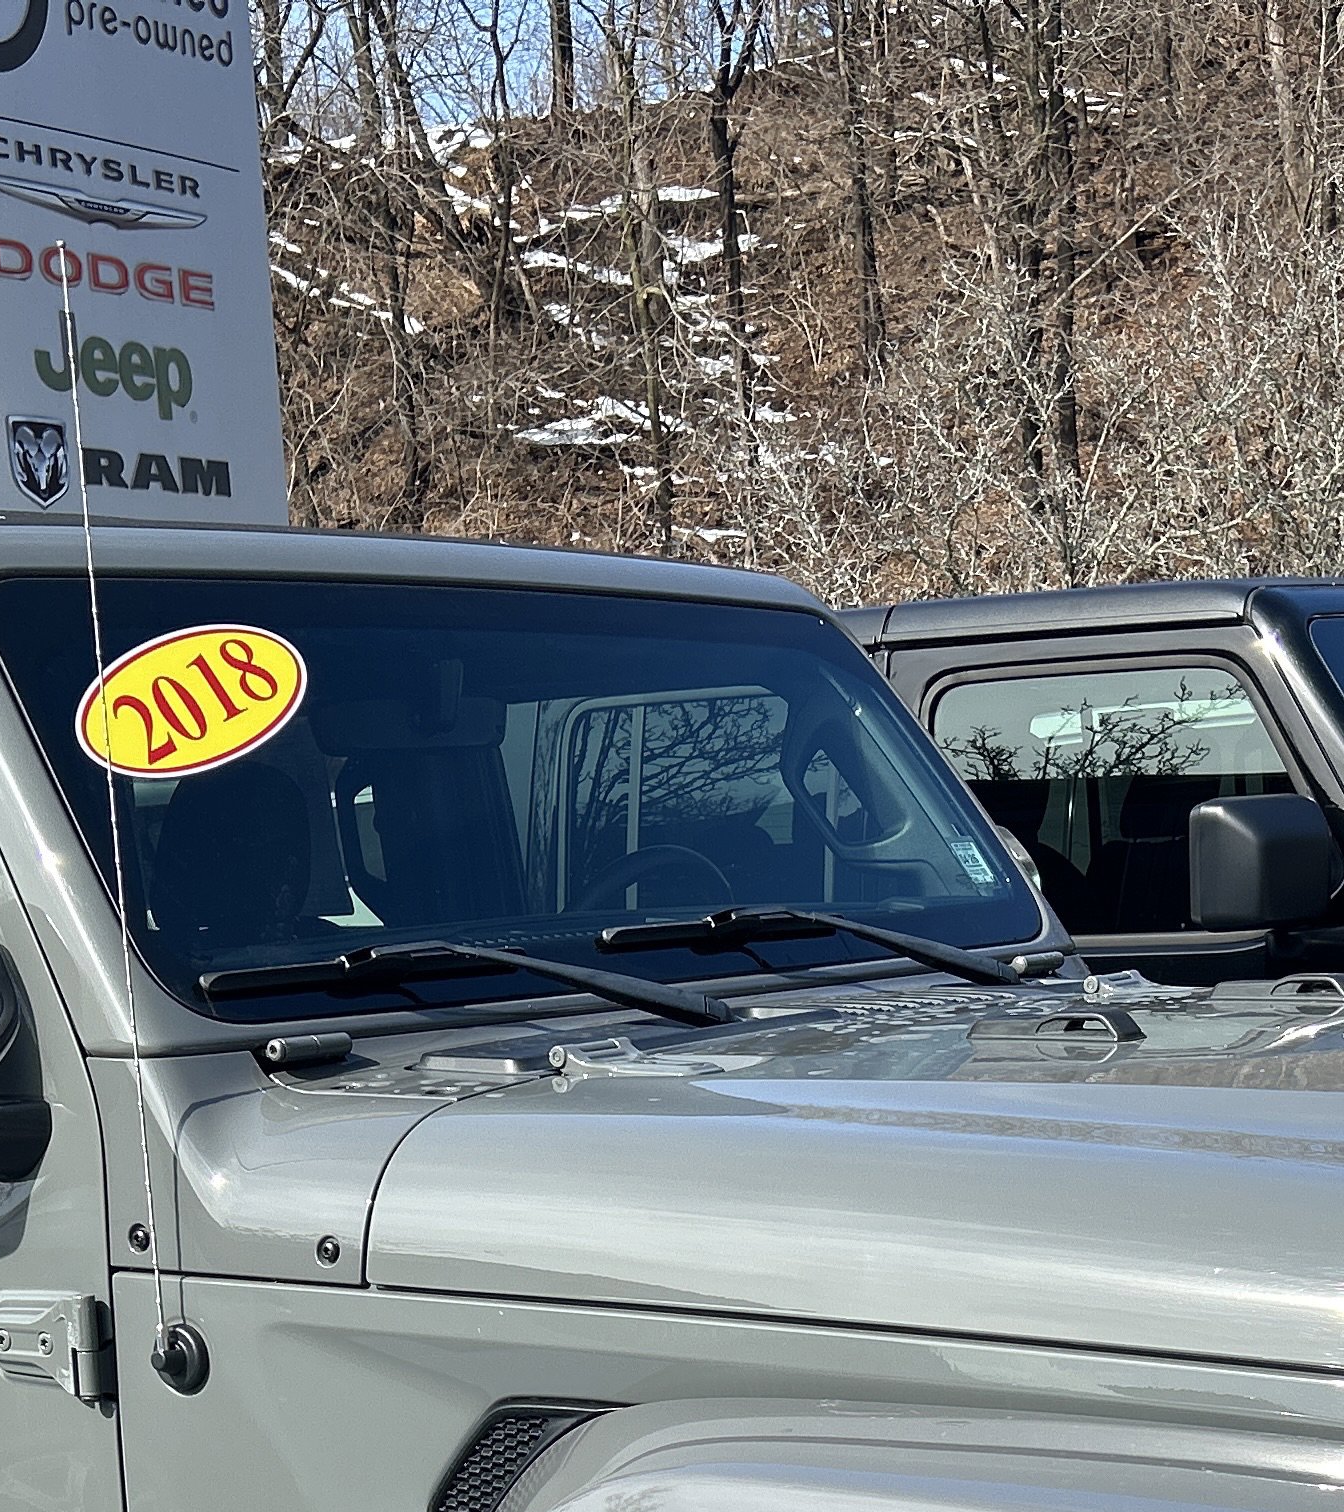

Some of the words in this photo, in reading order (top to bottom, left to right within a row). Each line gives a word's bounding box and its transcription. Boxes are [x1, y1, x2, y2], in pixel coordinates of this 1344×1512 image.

[65, 0, 233, 67] pre-owned
[34, 309, 193, 421] Jeep
[82, 447, 232, 498] RAM
[112, 638, 278, 765] 2018
